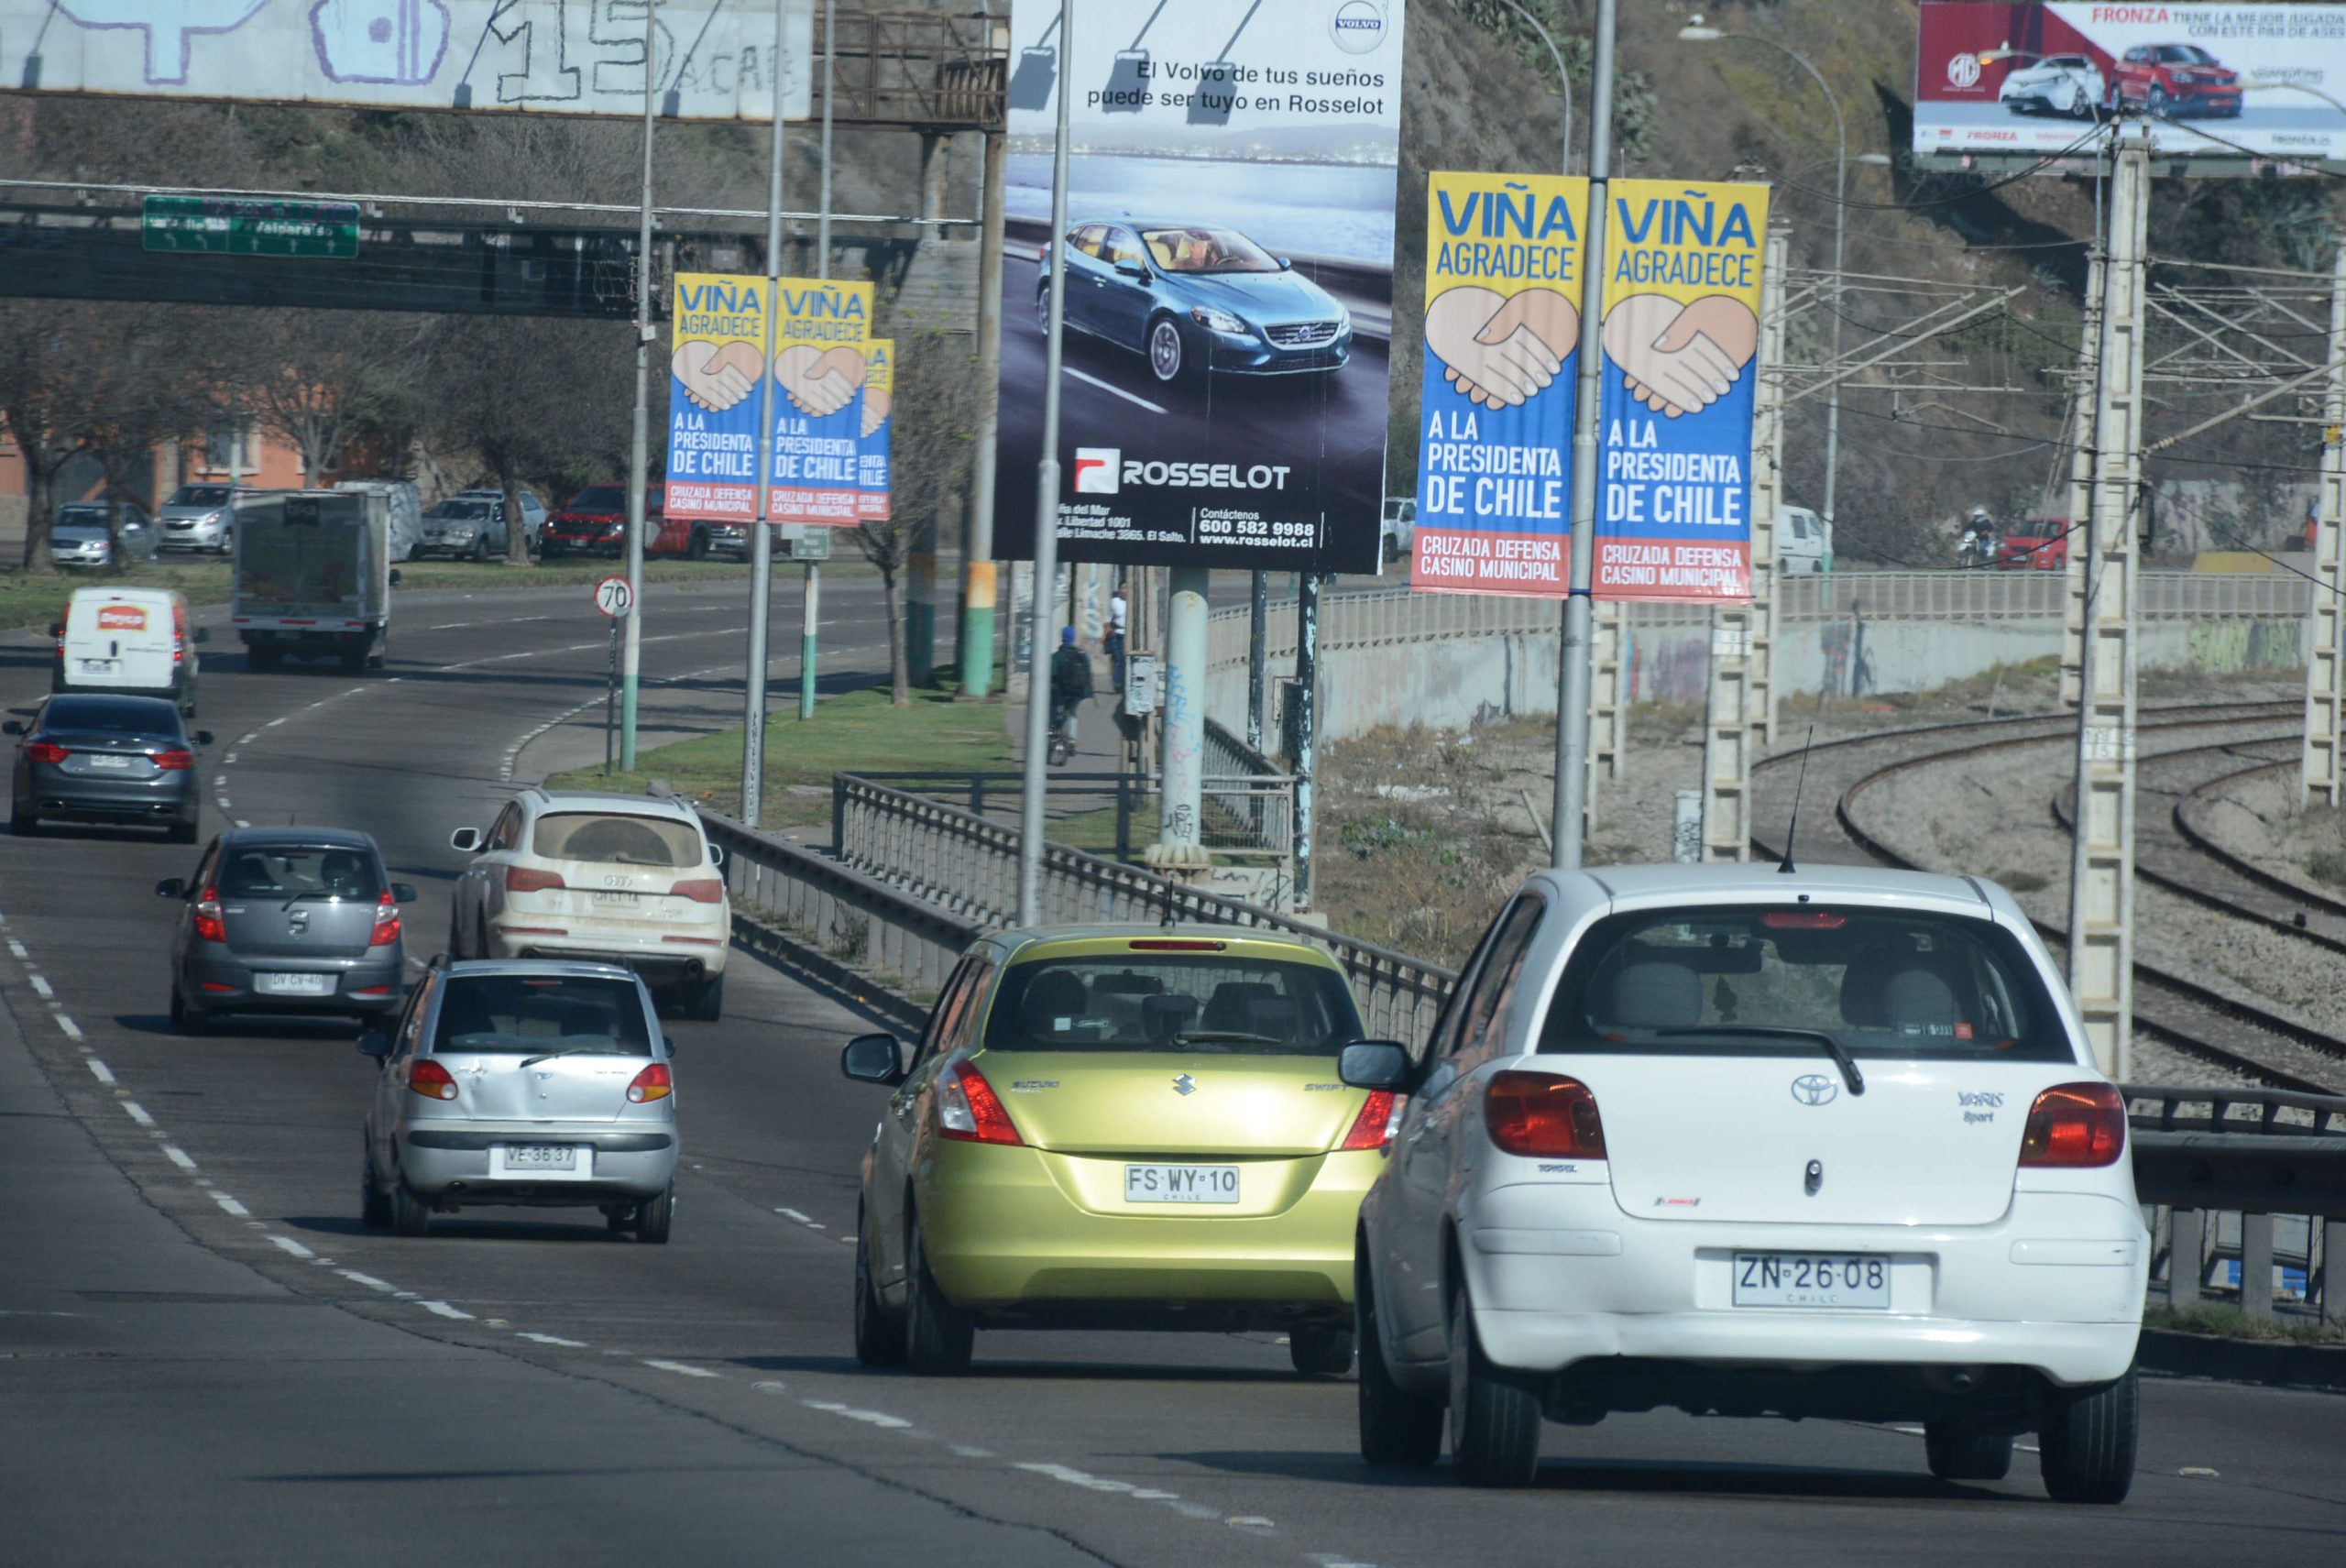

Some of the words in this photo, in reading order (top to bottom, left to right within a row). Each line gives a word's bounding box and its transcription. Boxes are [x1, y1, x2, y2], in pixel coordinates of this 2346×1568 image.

[1337, 18, 1380, 29] VOLVO
[2092, 7, 2169, 24] FRONZA
[2174, 11, 2210, 24] TIENE
[2215, 11, 2231, 24] LA
[2236, 12, 2284, 26] MEJOR
[2288, 13, 2345, 27] JUGADA
[2188, 26, 2218, 38] CON
[2221, 26, 2253, 38] ESTE
[2258, 27, 2285, 38] PAR
[2288, 27, 2308, 38] DE
[2310, 27, 2345, 38] ASES
[1137, 60, 1157, 80] El
[1166, 61, 1225, 82] Volvo
[1233, 64, 1258, 83] de
[1266, 67, 1298, 84] tus
[1306, 68, 1385, 88] sueños
[1087, 89, 1154, 107] puede
[1160, 93, 1194, 107] ser
[1201, 93, 1248, 114] tuyo
[1255, 96, 1281, 112] en
[1288, 94, 1384, 115] Rosselot
[1436, 181, 1577, 241] VIÑA
[1616, 189, 1757, 248] VIÑA
[1435, 241, 1574, 281] AGRADECE
[1615, 249, 1755, 288] AGRADECE
[679, 280, 762, 314] VIÑA
[783, 285, 866, 321] VIÑA
[678, 314, 761, 337] AGRADECE
[782, 319, 865, 342] AGRADECE
[674, 411, 684, 430] A
[687, 412, 705, 431] LA
[776, 418, 786, 434] A
[790, 418, 807, 435] LA
[1428, 410, 1444, 440] A
[1451, 410, 1478, 441] LA
[674, 431, 753, 453] PRESIDENTA
[1607, 418, 1624, 448] A
[1629, 419, 1658, 448] LA
[775, 435, 857, 456] PRESIDENTA
[673, 451, 696, 474] DE
[701, 452, 753, 477] CHILE
[774, 455, 799, 478] DE
[803, 456, 858, 481] CHILE
[1427, 443, 1562, 477] PRESIDENTA
[1606, 451, 1741, 484] PRESIDENTA
[1123, 460, 1291, 490] ROSSELOT
[670, 485, 711, 499] CRUZADA
[713, 487, 752, 500] DEFENSA
[772, 489, 814, 504] CRUZADA
[1426, 475, 1466, 514] DE
[1474, 476, 1562, 519] CHILE
[670, 497, 702, 510] CASINO
[704, 499, 751, 513] MUNICIPAL
[772, 502, 804, 515] CASINO
[806, 503, 855, 517] MUNICIPAL
[1072, 504, 1089, 515] del
[1090, 504, 1111, 516] Mar
[1200, 507, 1260, 521] Contáctenos
[1606, 483, 1647, 522] DE
[1653, 485, 1742, 526] CHILE
[1065, 515, 1105, 528] Libertad
[1199, 519, 1232, 534] 600
[1236, 521, 1268, 535] 582
[1273, 521, 1314, 537] 9988
[1074, 528, 1116, 540] Limache
[1146, 531, 1157, 542] El
[1199, 533, 1314, 548] www.rosselot.cl
[1421, 535, 1490, 558] CRUZADA
[1495, 539, 1561, 561] DEFENSA
[1602, 544, 1670, 566] CRUZADA
[1674, 546, 1741, 568] DEFENSA
[1420, 556, 1474, 578] CASINO
[1479, 560, 1561, 582] MUNICIPAL
[1601, 565, 1656, 586] CASINO
[1660, 567, 1741, 588] MUNICIPAL
[603, 585, 628, 608] 70
[1304, 1083, 1347, 1091] SWIFT
[1957, 1091, 2004, 1107] YARIS
[1963, 1111, 1994, 1124] Sport
[1163, 1193, 1201, 1201] CHILE
[1787, 1294, 1839, 1304] CHILE
